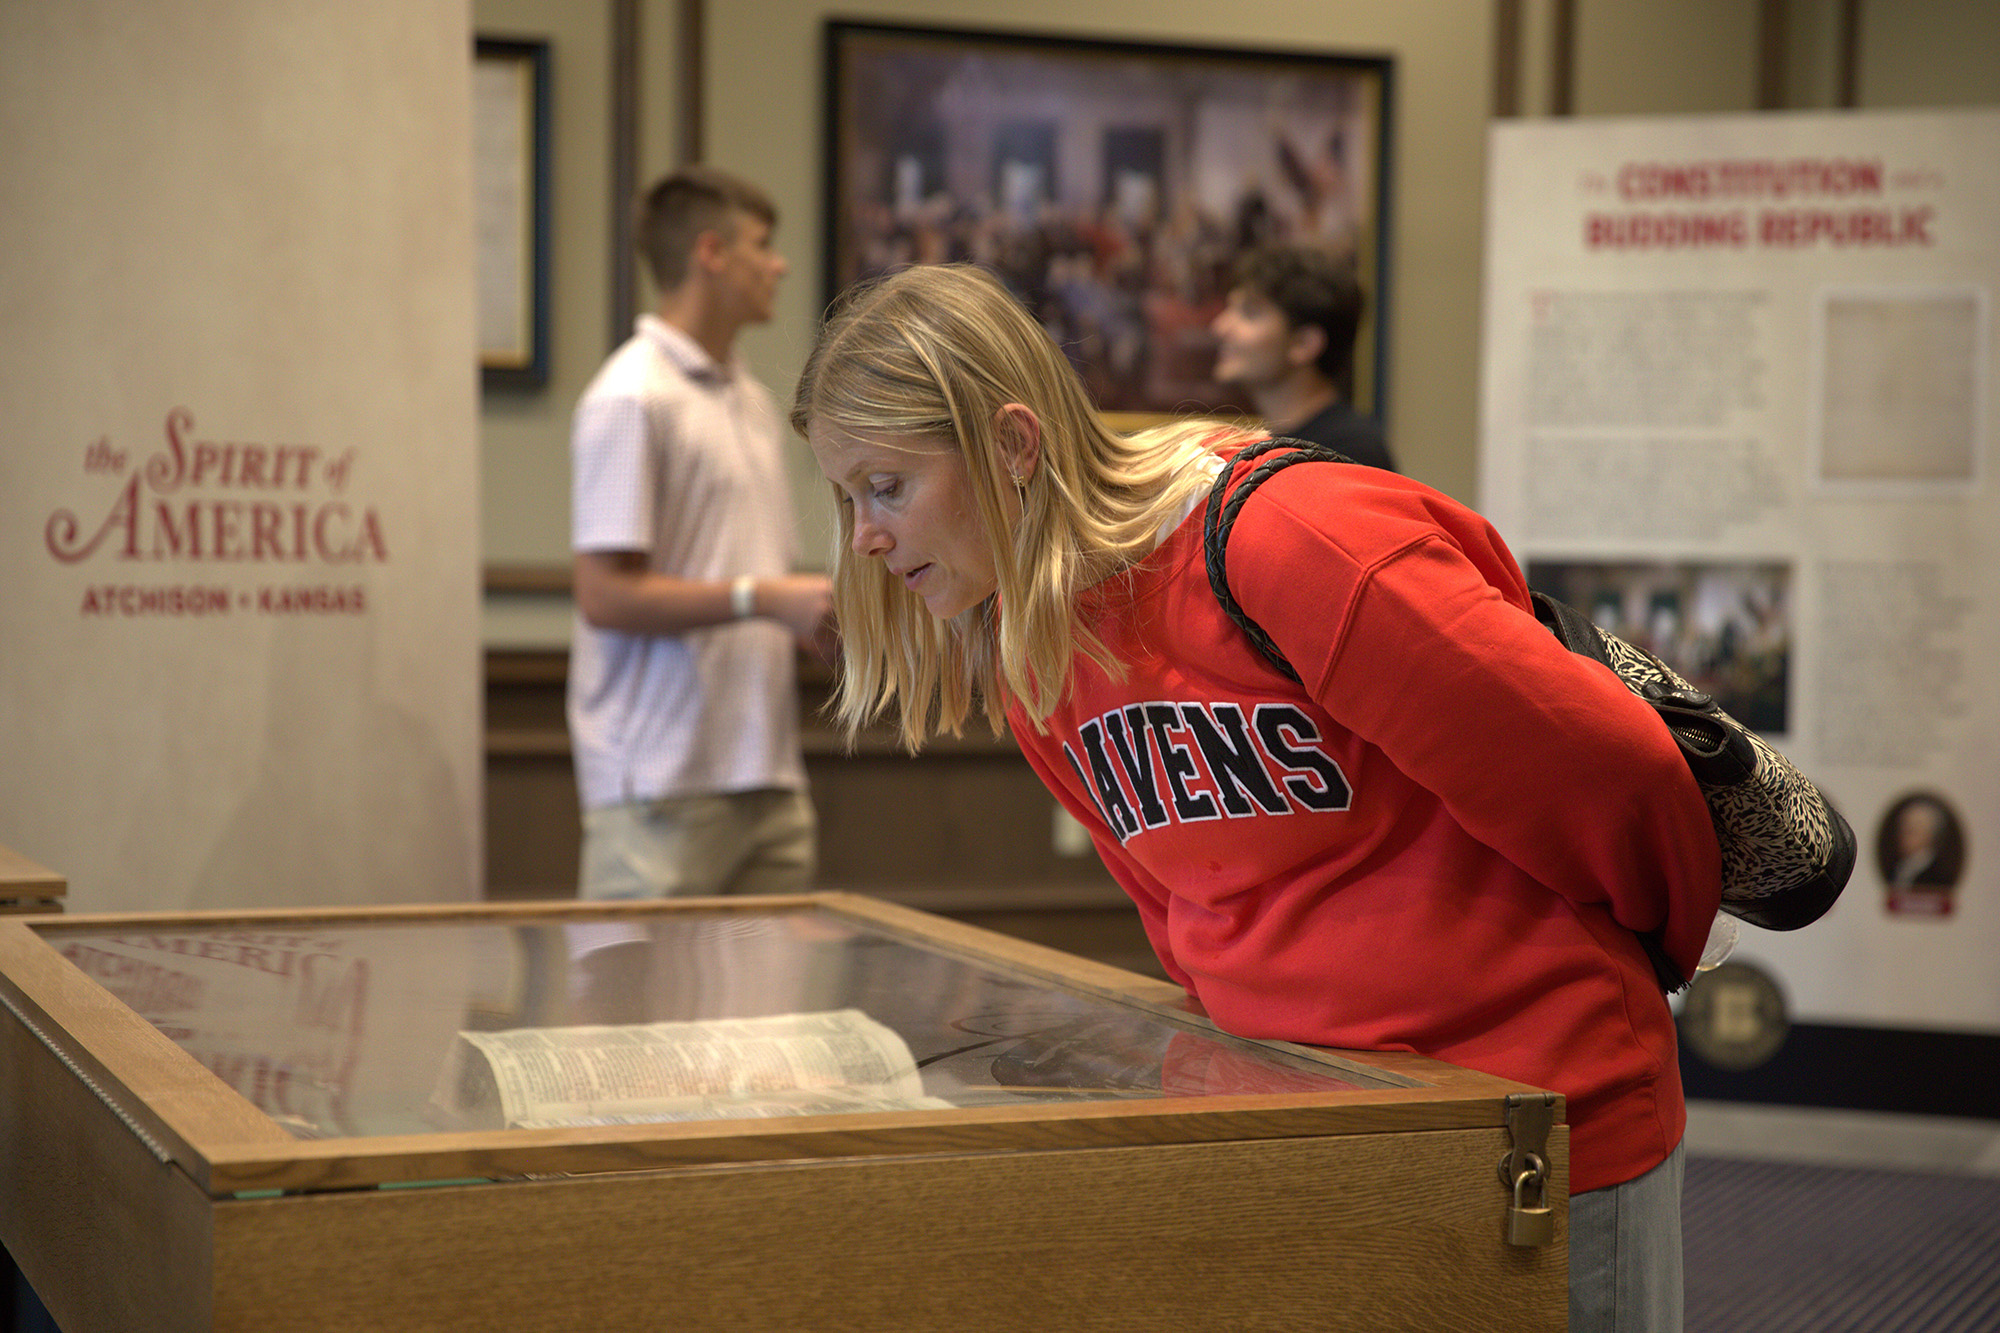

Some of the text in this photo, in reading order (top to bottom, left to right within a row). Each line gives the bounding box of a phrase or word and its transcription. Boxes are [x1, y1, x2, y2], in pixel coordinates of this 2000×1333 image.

[84, 406, 356, 494] the SPIRIT of
[45, 469, 388, 565] AMERICA
[82, 587, 366, 615] ATCHISON KANSAS
[1063, 702, 1353, 846] AVENS
